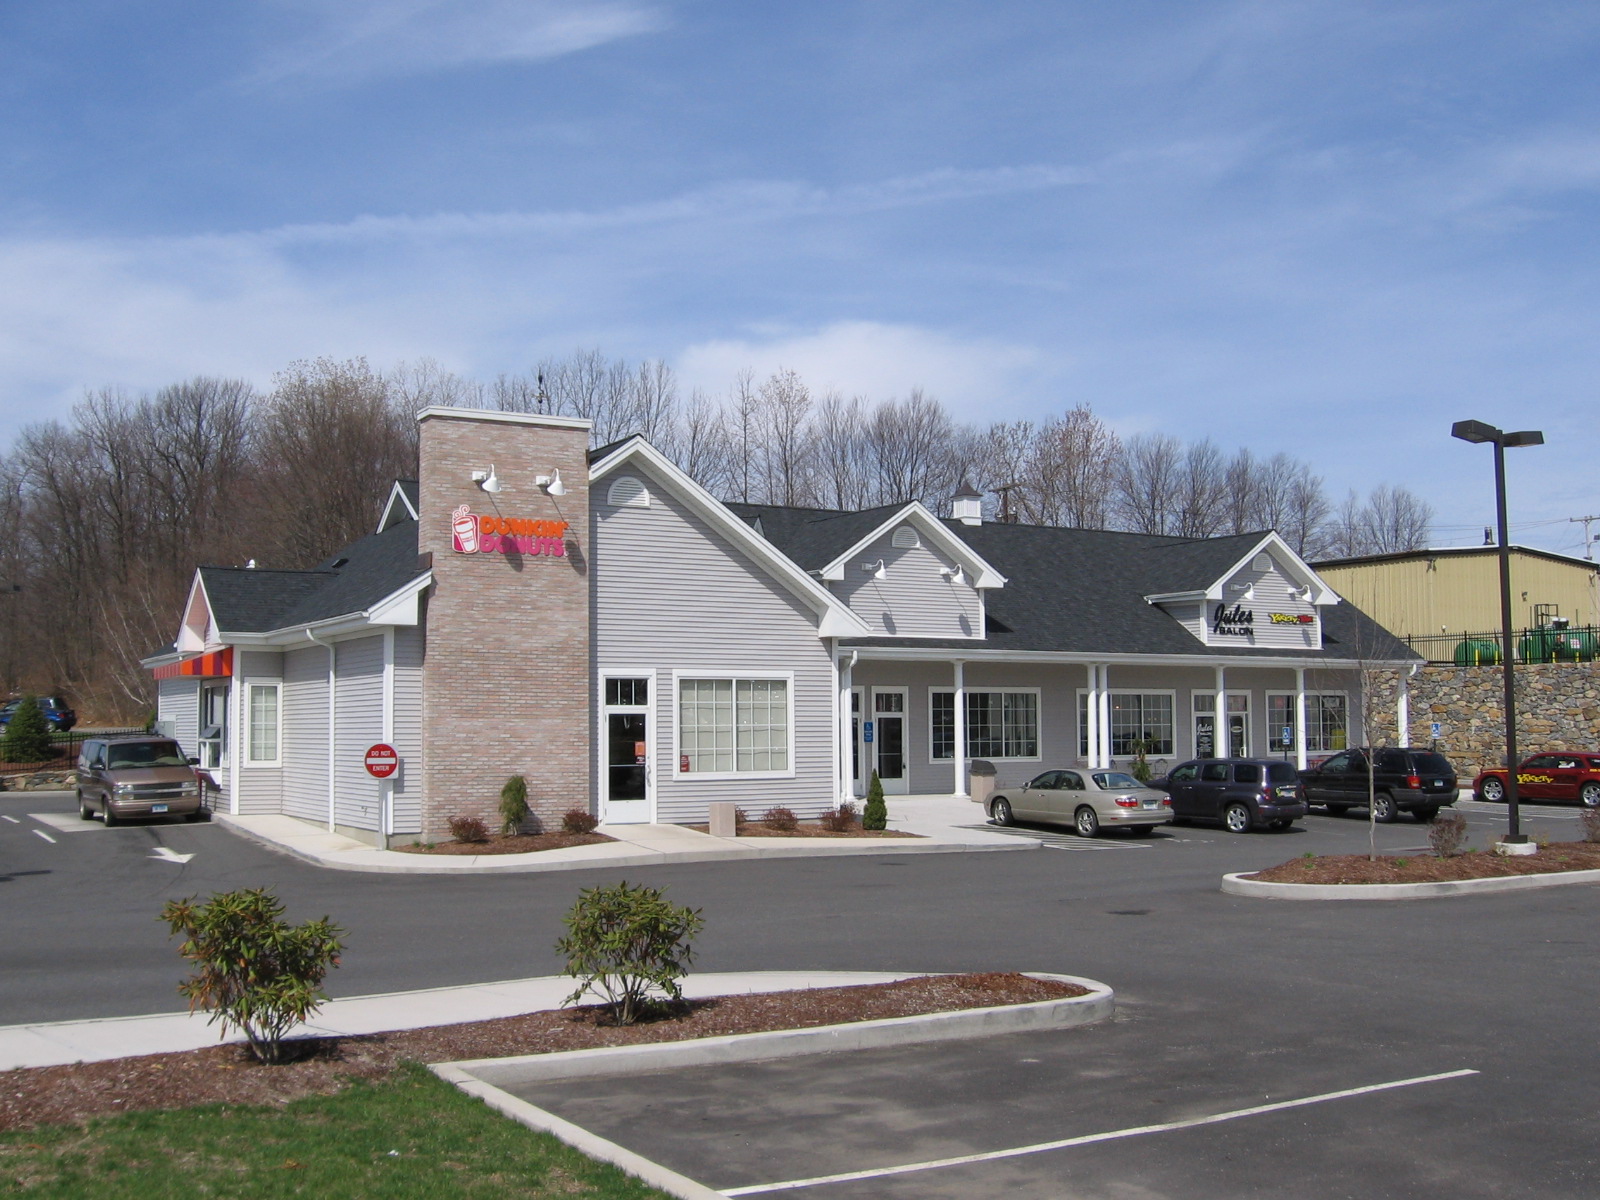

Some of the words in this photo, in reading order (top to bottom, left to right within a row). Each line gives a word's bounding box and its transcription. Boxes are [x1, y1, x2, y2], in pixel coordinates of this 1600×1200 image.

[480, 516, 569, 538] DUNKIN'
[480, 534, 565, 557] DONUTS
[1213, 603, 1254, 633] Jules
[1219, 626, 1254, 636] SALON
